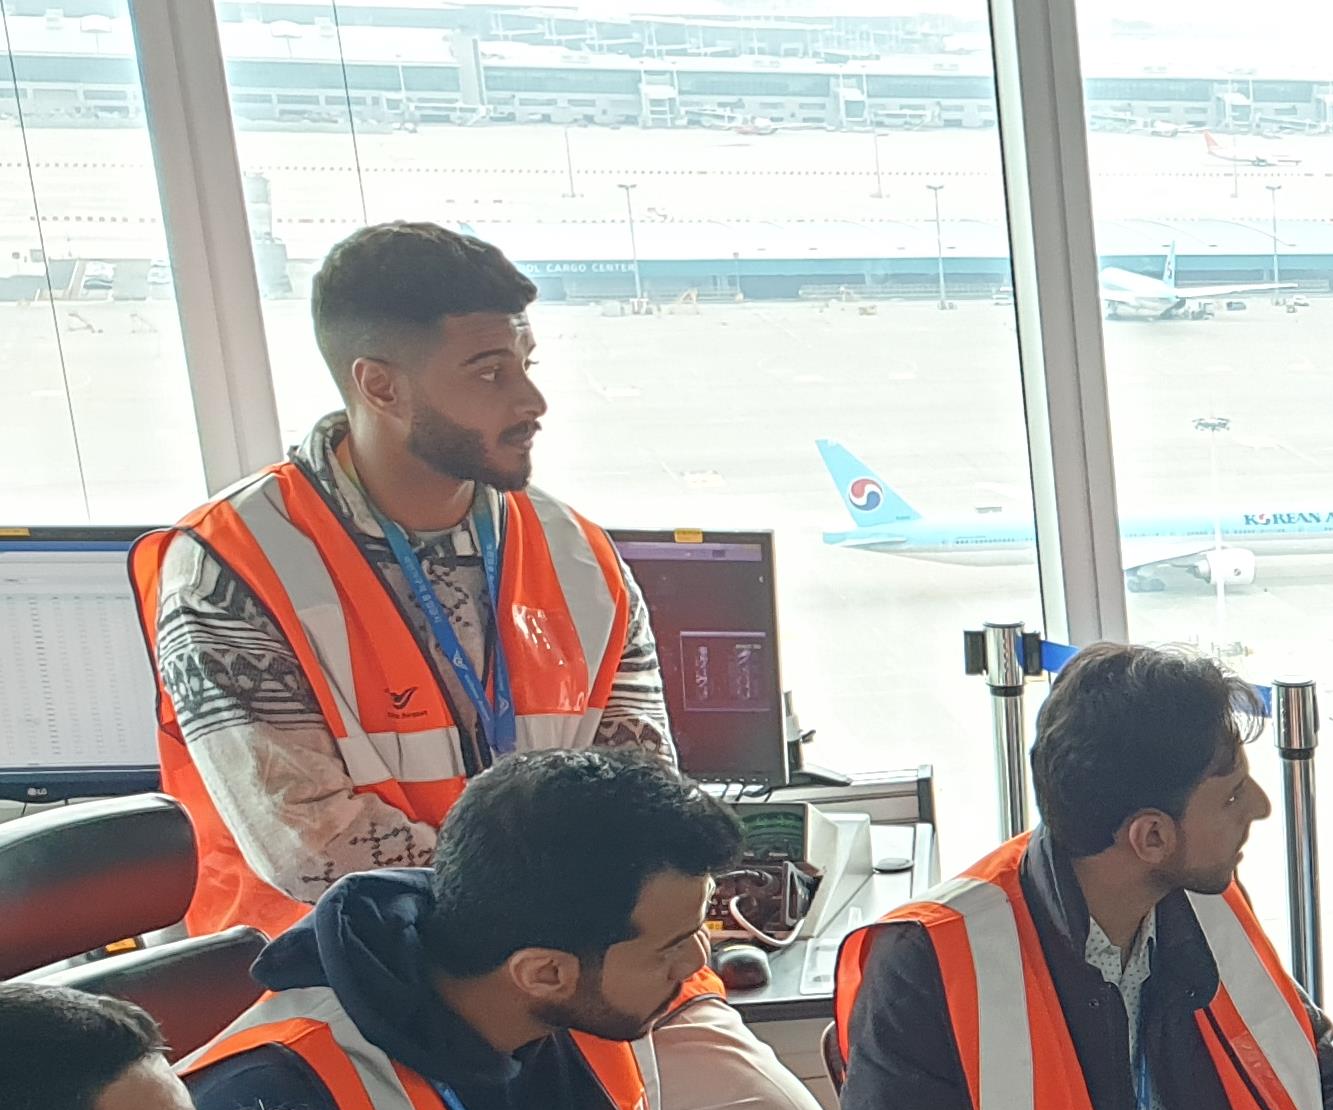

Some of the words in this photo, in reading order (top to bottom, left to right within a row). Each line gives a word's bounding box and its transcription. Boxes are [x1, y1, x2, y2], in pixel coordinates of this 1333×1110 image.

[546, 263, 587, 273] CARGO
[591, 263, 637, 273] CENTER
[1243, 512, 1322, 526] KOREAN
